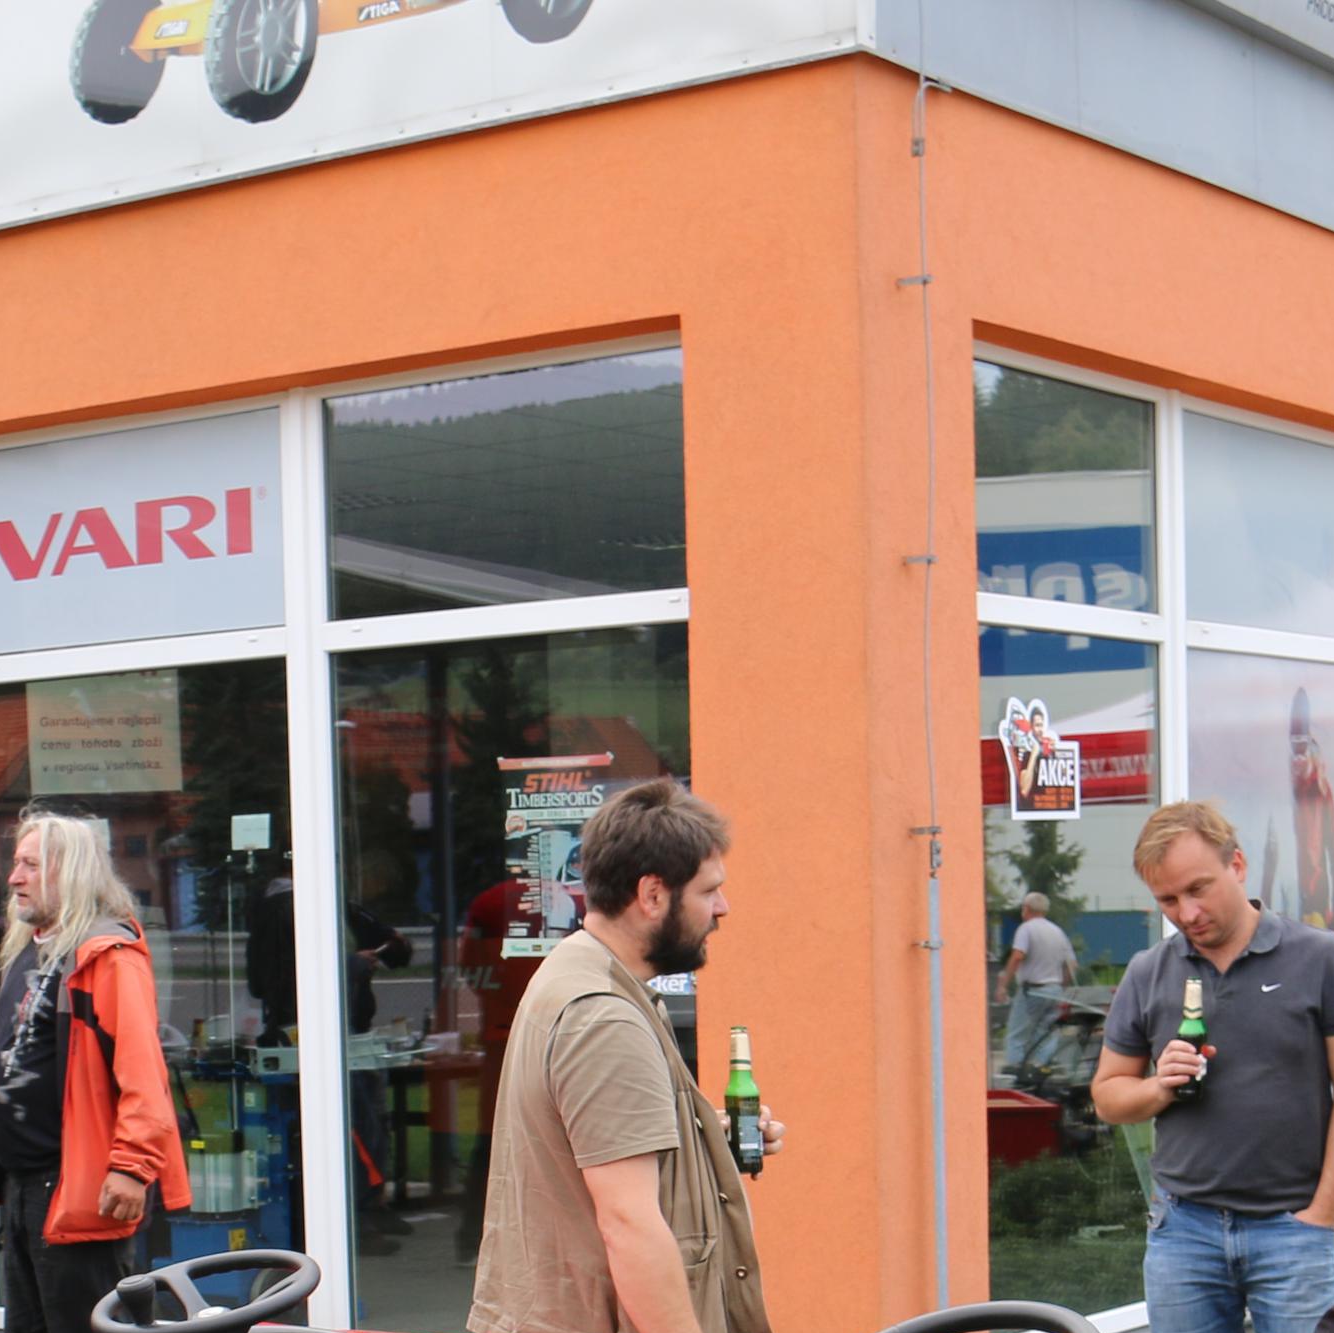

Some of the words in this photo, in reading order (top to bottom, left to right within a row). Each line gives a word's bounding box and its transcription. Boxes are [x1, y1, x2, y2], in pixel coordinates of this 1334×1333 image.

[40, 715, 114, 729] Garantujeme
[41, 741, 71, 750] cenu
[81, 738, 122, 750] tohoto
[1037, 758, 1075, 786] AKCE
[523, 771, 588, 793] STIHL
